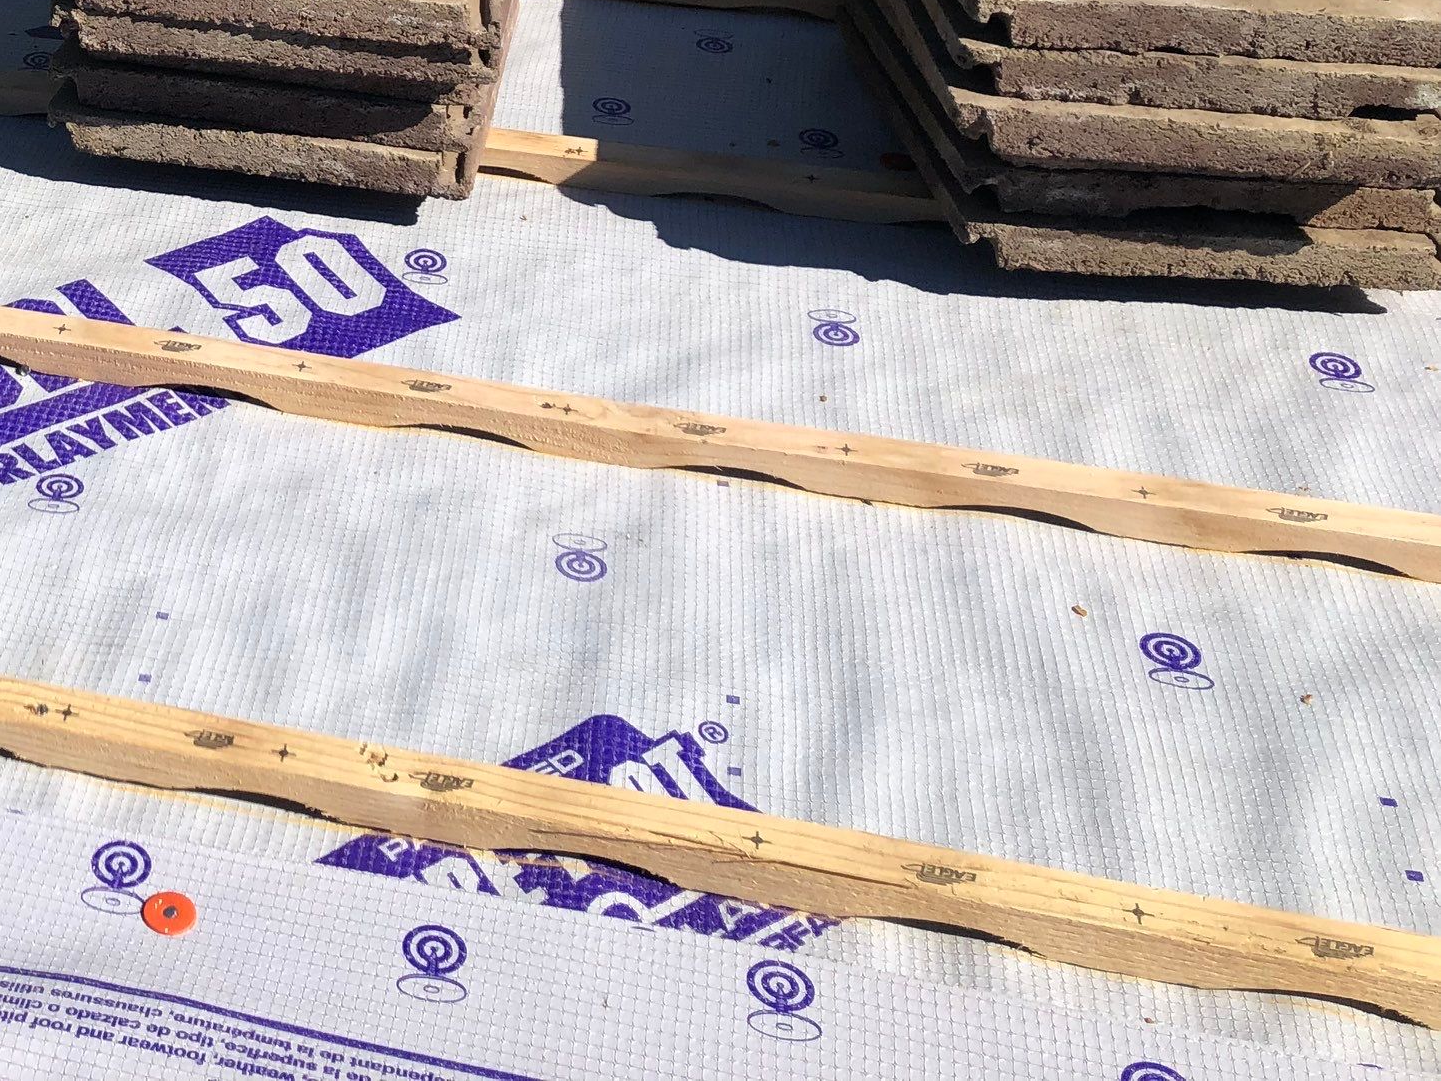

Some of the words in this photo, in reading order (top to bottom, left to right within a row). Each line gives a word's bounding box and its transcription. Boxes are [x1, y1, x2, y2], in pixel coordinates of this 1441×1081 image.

[194, 235, 388, 345] 50
[47, 1003, 62, 1014] o
[50, 988, 164, 1019] chaussures
[29, 1016, 73, 1034] roof
[65, 1006, 142, 1032] calzado
[74, 1024, 116, 1043] and
[146, 1023, 171, 1039] de
[176, 1029, 214, 1048] tipo
[118, 1035, 207, 1066] footwear
